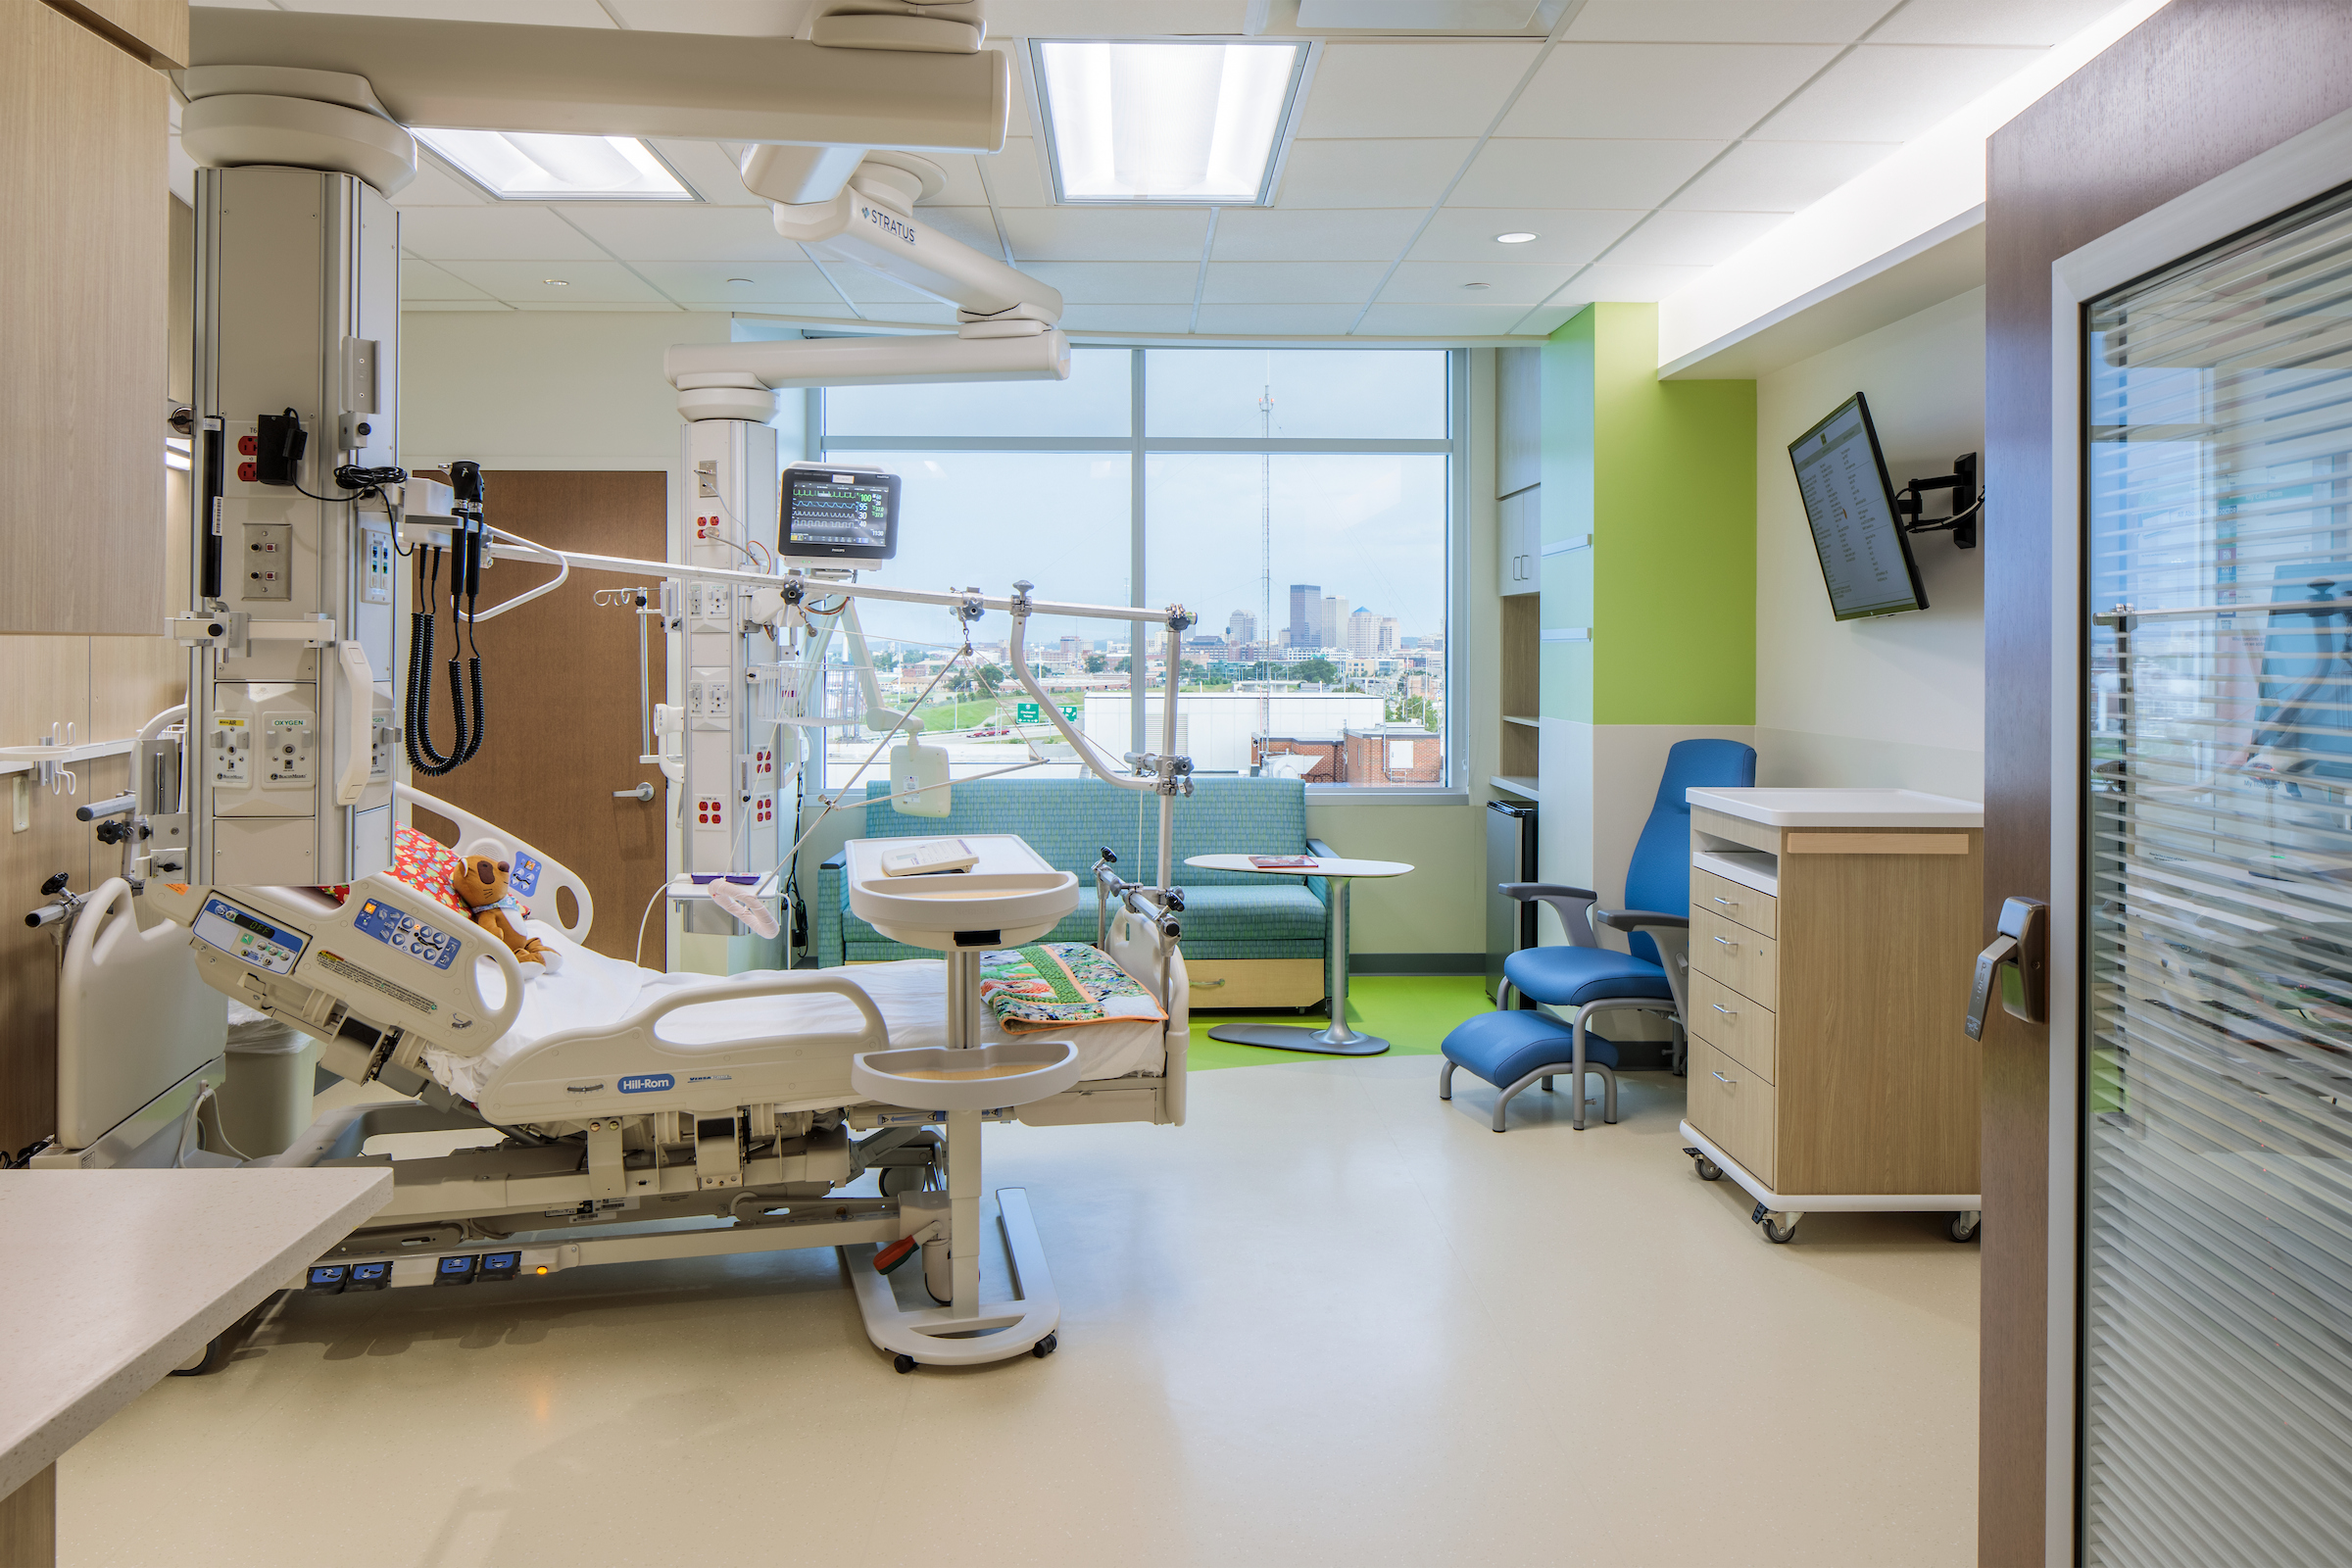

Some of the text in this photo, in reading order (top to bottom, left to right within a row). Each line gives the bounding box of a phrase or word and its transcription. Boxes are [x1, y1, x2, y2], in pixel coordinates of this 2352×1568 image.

[871, 209, 915, 243] STRATUS
[860, 493, 872, 502] 100
[2255, 491, 2268, 500] Care
[858, 503, 868, 512] 95
[2223, 551, 2231, 560] RN
[250, 922, 270, 934] OFF
[623, 1078, 669, 1091] Hill-Rom
